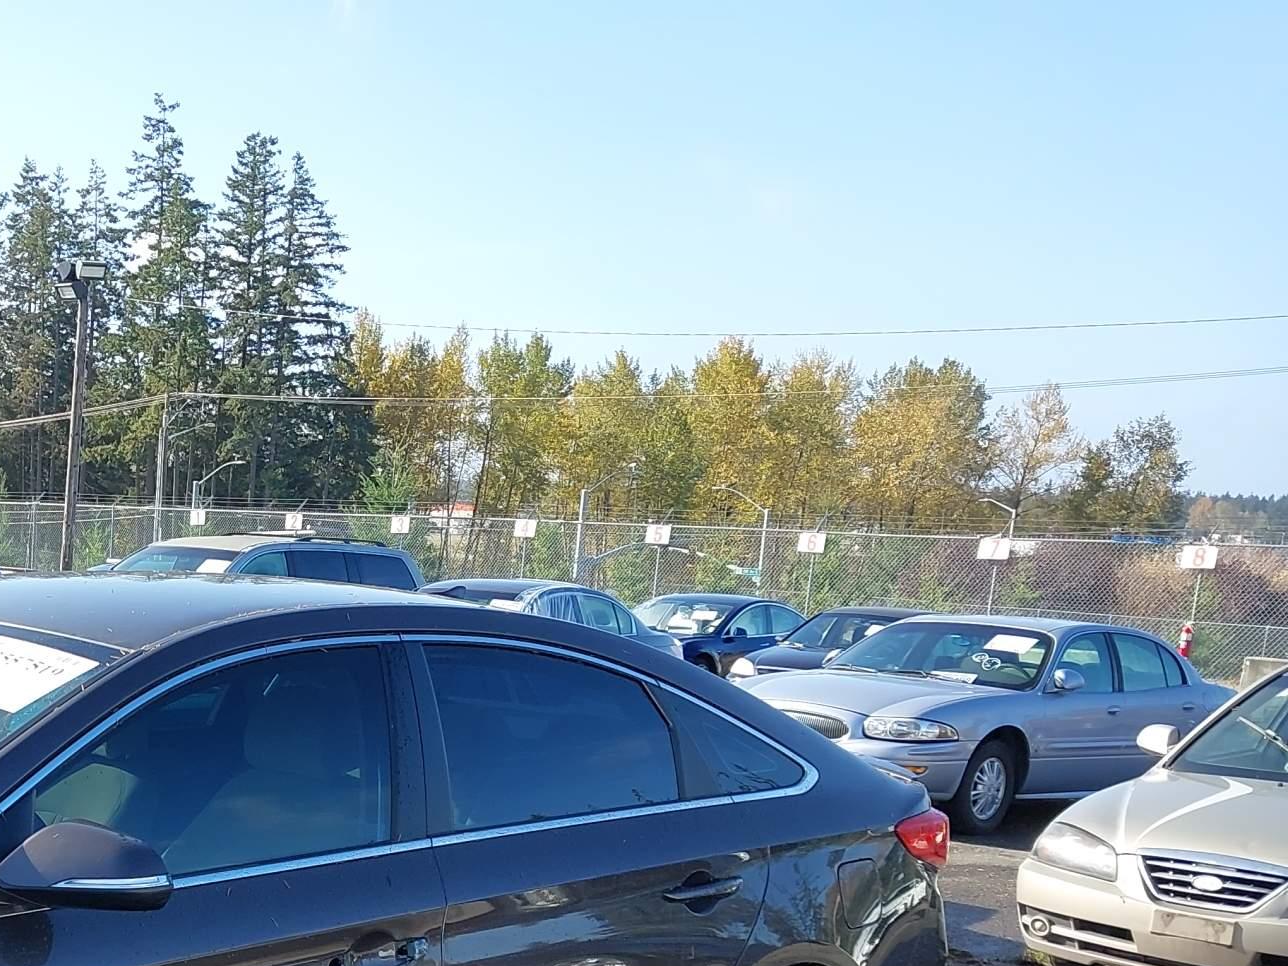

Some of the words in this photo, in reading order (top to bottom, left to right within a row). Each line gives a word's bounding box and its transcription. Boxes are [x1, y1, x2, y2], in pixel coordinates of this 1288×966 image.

[289, 514, 298, 528] 2
[396, 517, 404, 532] 3
[520, 520, 529, 536] 4
[653, 526, 663, 543] 5
[807, 533, 817, 551] 6
[988, 539, 1000, 558] 7
[1192, 547, 1206, 567] 8
